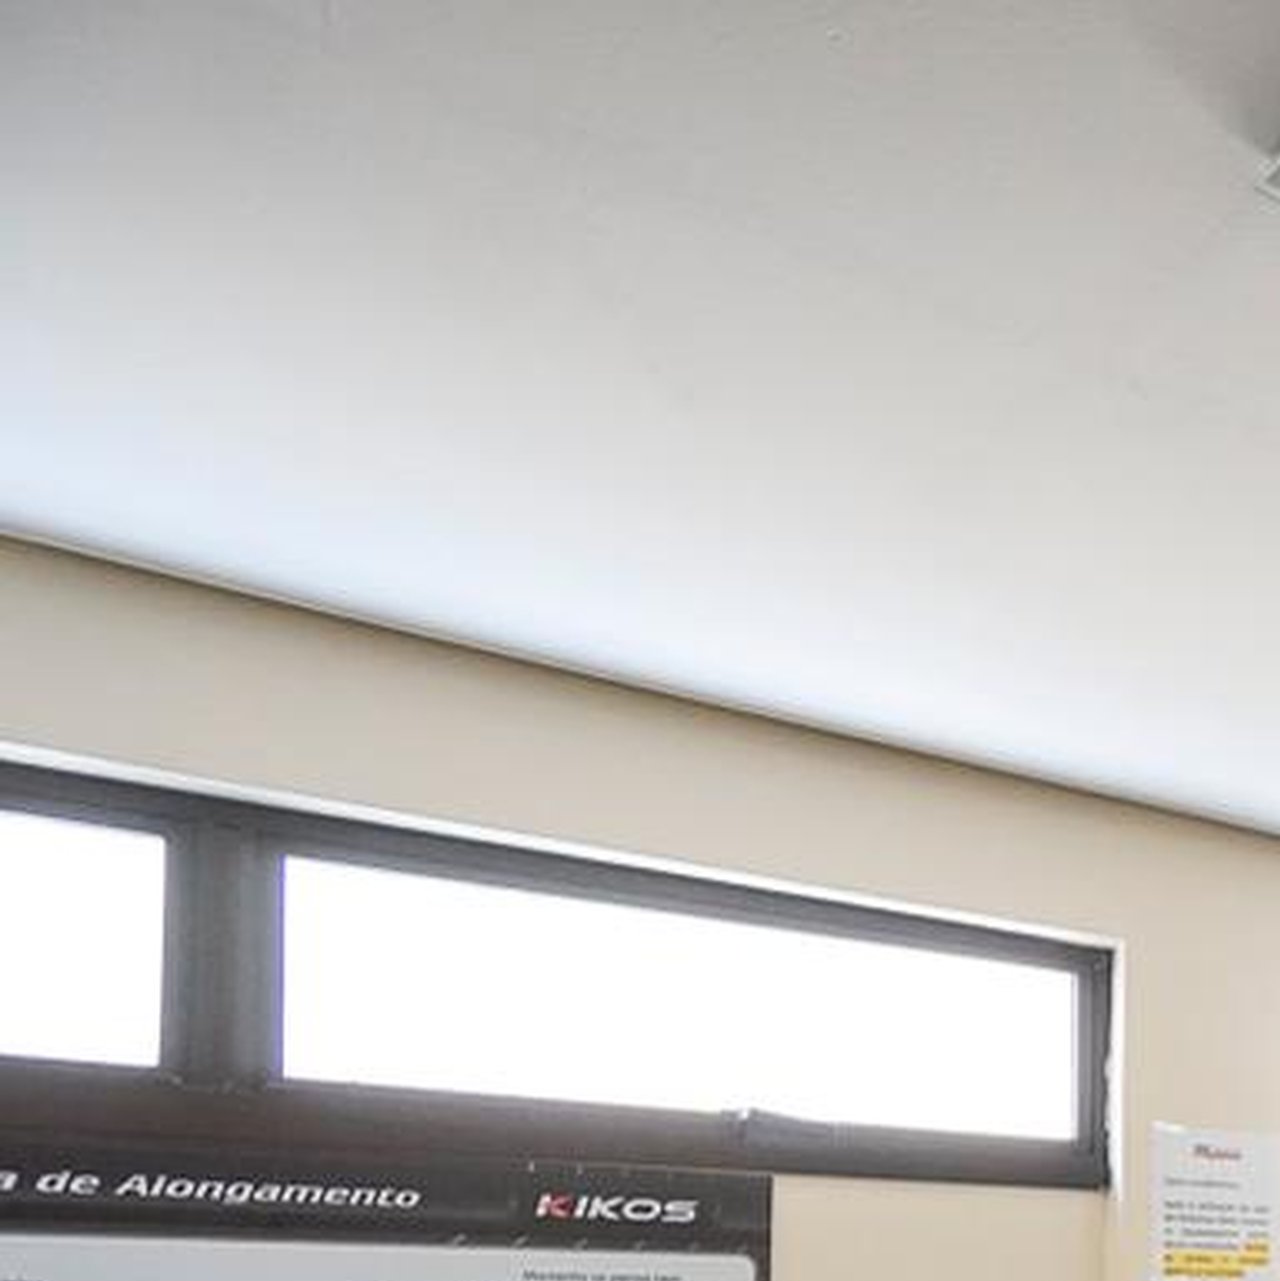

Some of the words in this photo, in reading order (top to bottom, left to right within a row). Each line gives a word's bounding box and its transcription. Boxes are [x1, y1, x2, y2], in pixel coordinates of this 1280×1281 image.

[36, 1171, 99, 1195] de
[115, 1174, 421, 1208] Alongamento
[535, 1193, 698, 1223] KIKOS
